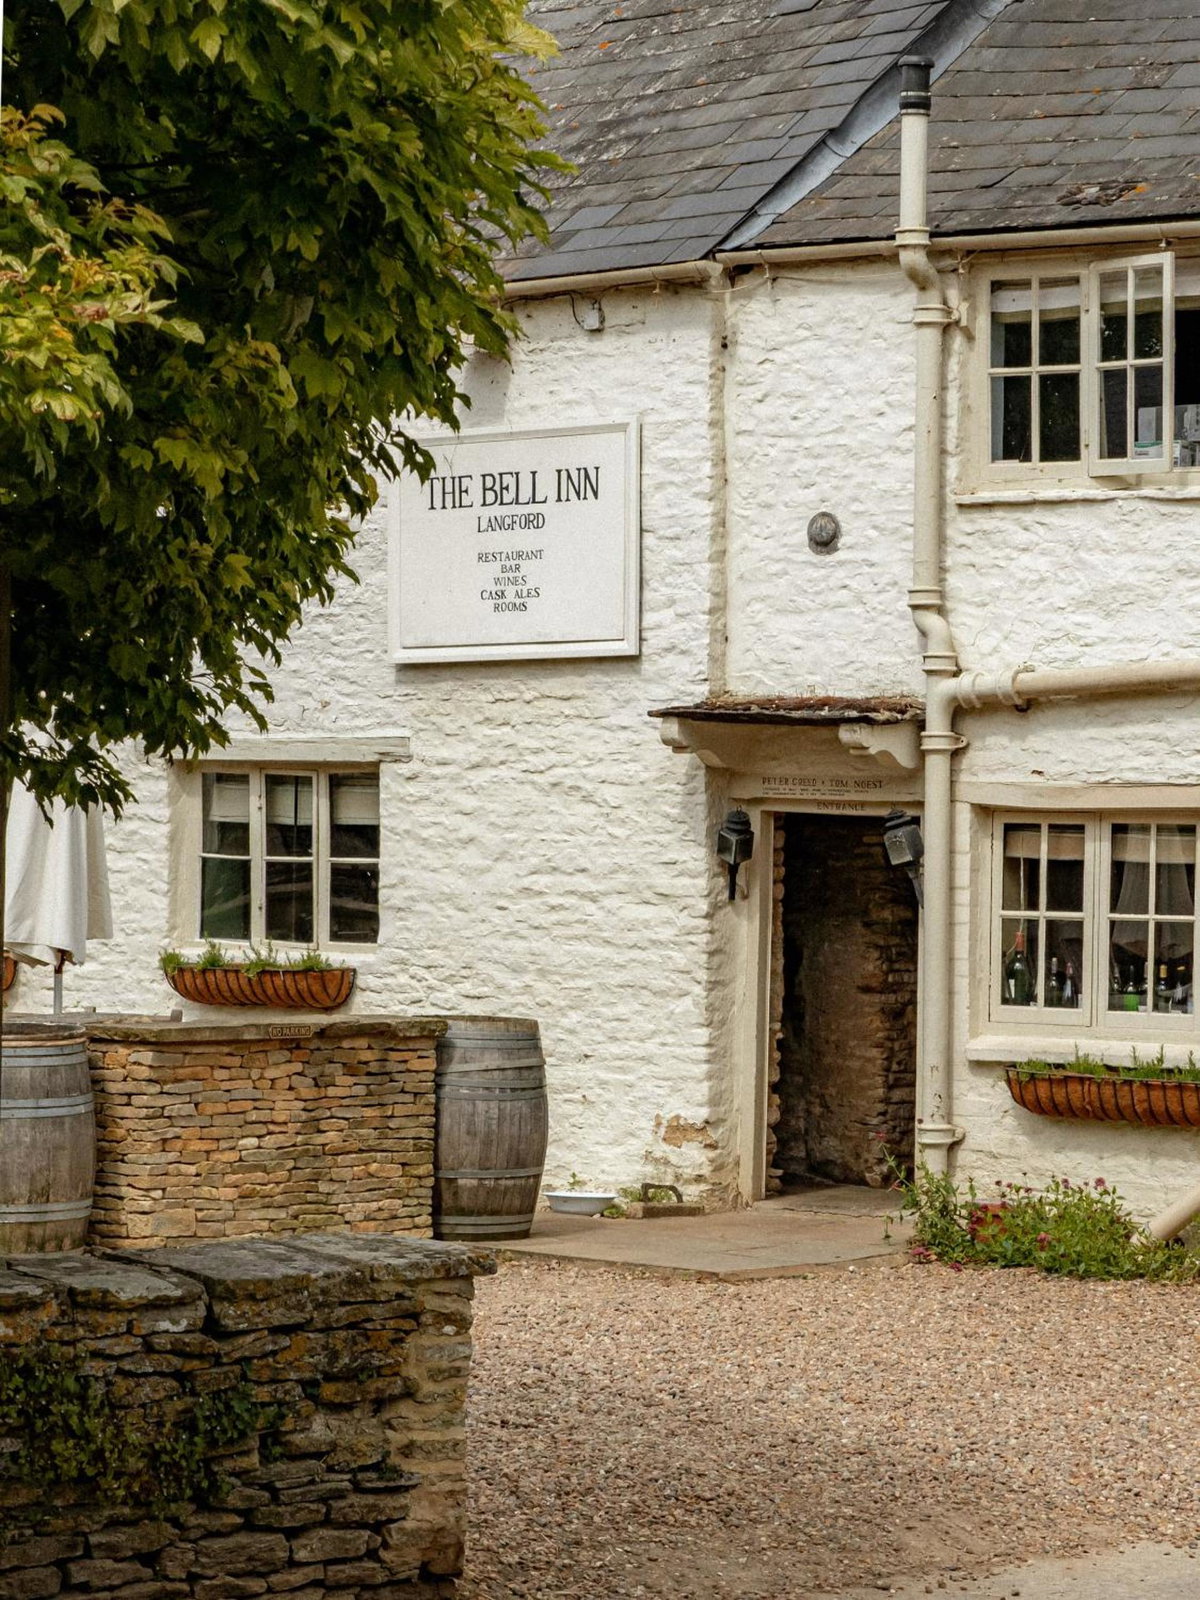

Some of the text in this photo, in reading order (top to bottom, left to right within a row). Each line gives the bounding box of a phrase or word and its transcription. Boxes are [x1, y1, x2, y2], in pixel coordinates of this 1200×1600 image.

[428, 466, 600, 510] THE BELL INN
[477, 513, 546, 533] LANGFORD
[477, 549, 544, 563] RESTAURANT
[500, 563, 521, 574] BAR
[493, 575, 527, 587] WINES
[480, 587, 541, 601] CASK ALES
[493, 601, 528, 613] ROOMS
[829, 778, 849, 788] TOM
[816, 802, 865, 811] ENTRANCE
[273, 1028, 282, 1036] NO
